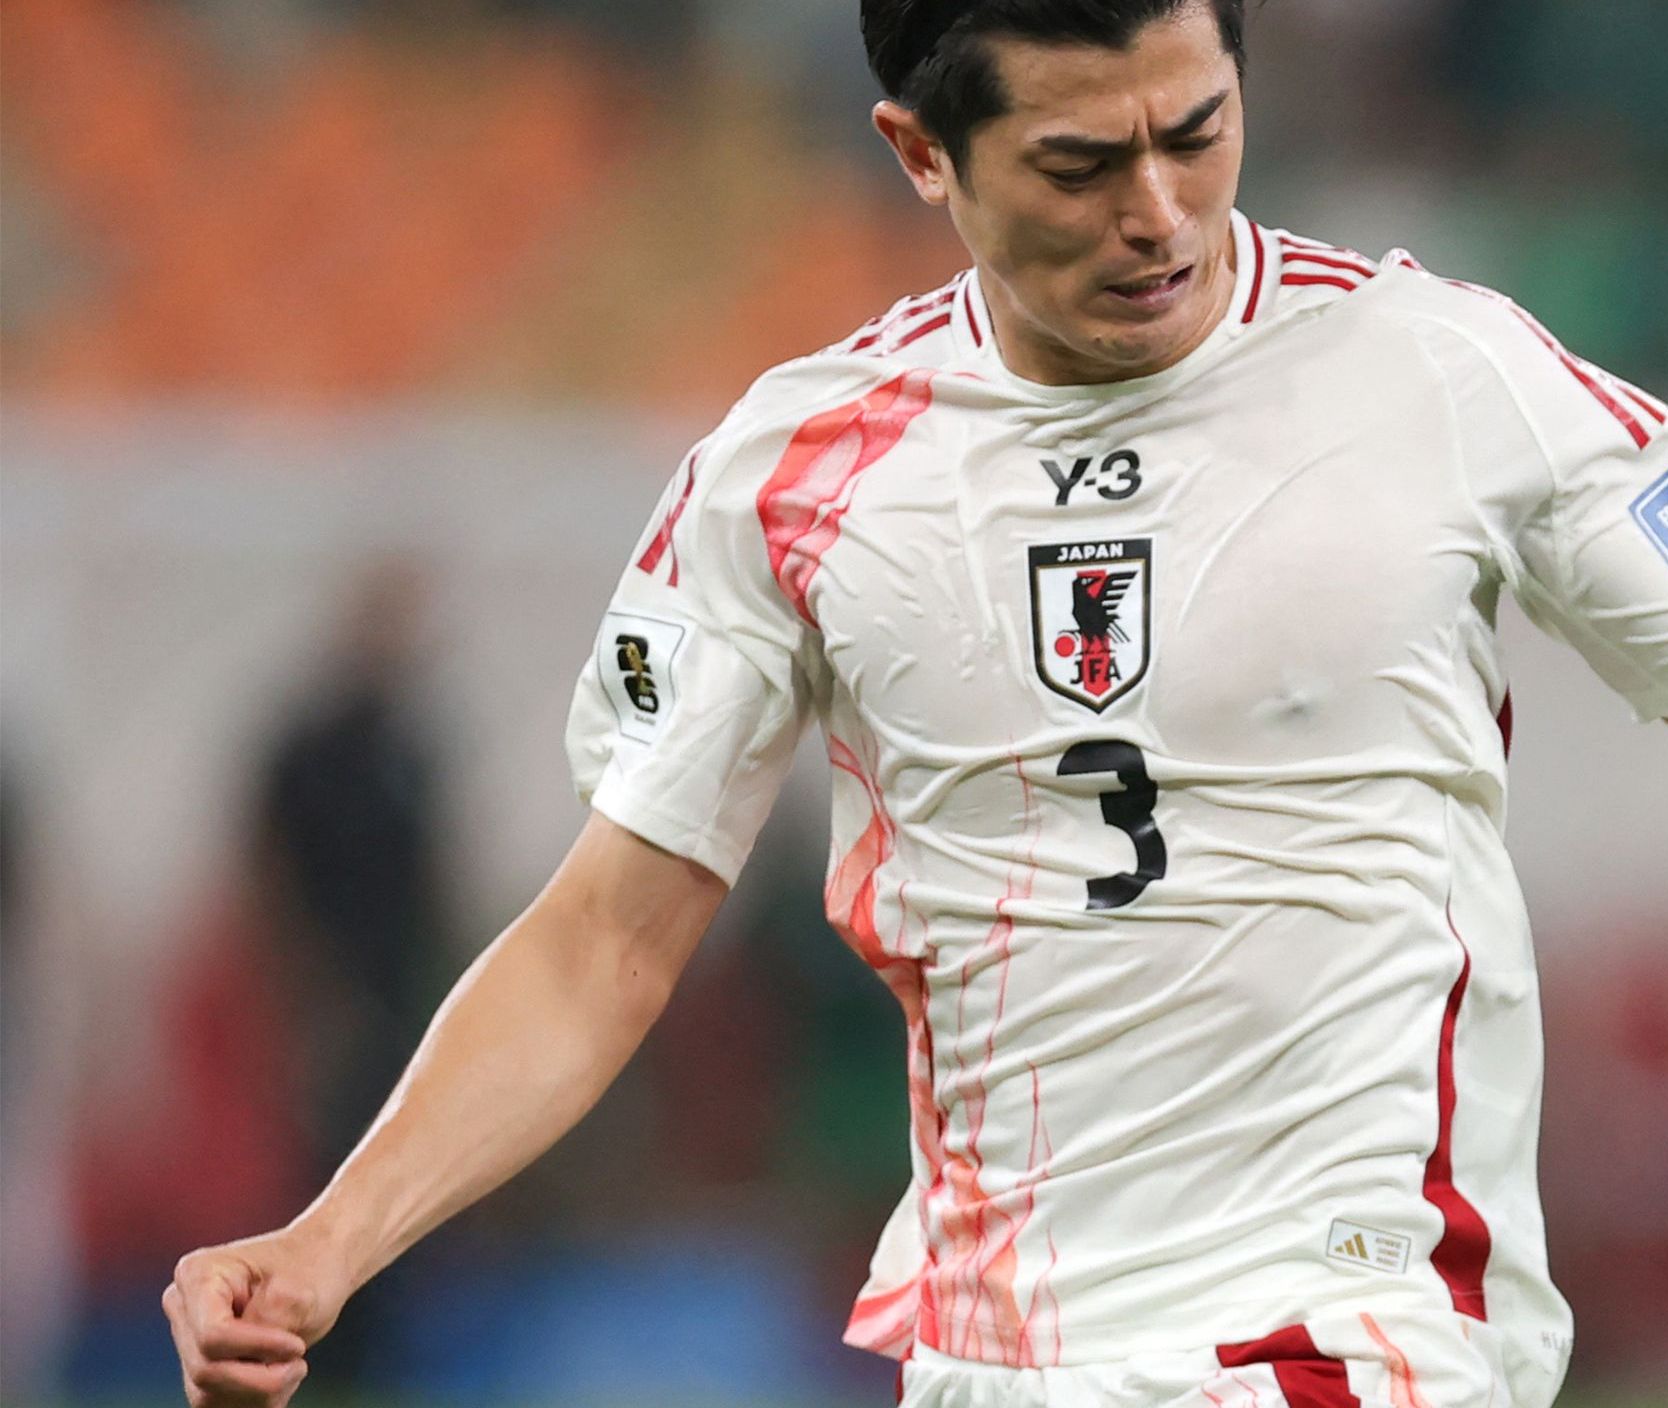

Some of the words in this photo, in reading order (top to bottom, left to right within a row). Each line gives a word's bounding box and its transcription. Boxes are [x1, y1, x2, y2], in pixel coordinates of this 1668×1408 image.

[1040, 448, 1141, 506] Y-3
[1057, 543, 1124, 561] JAPAN
[1070, 656, 1122, 685] JFA
[1056, 738, 1167, 910] 3
